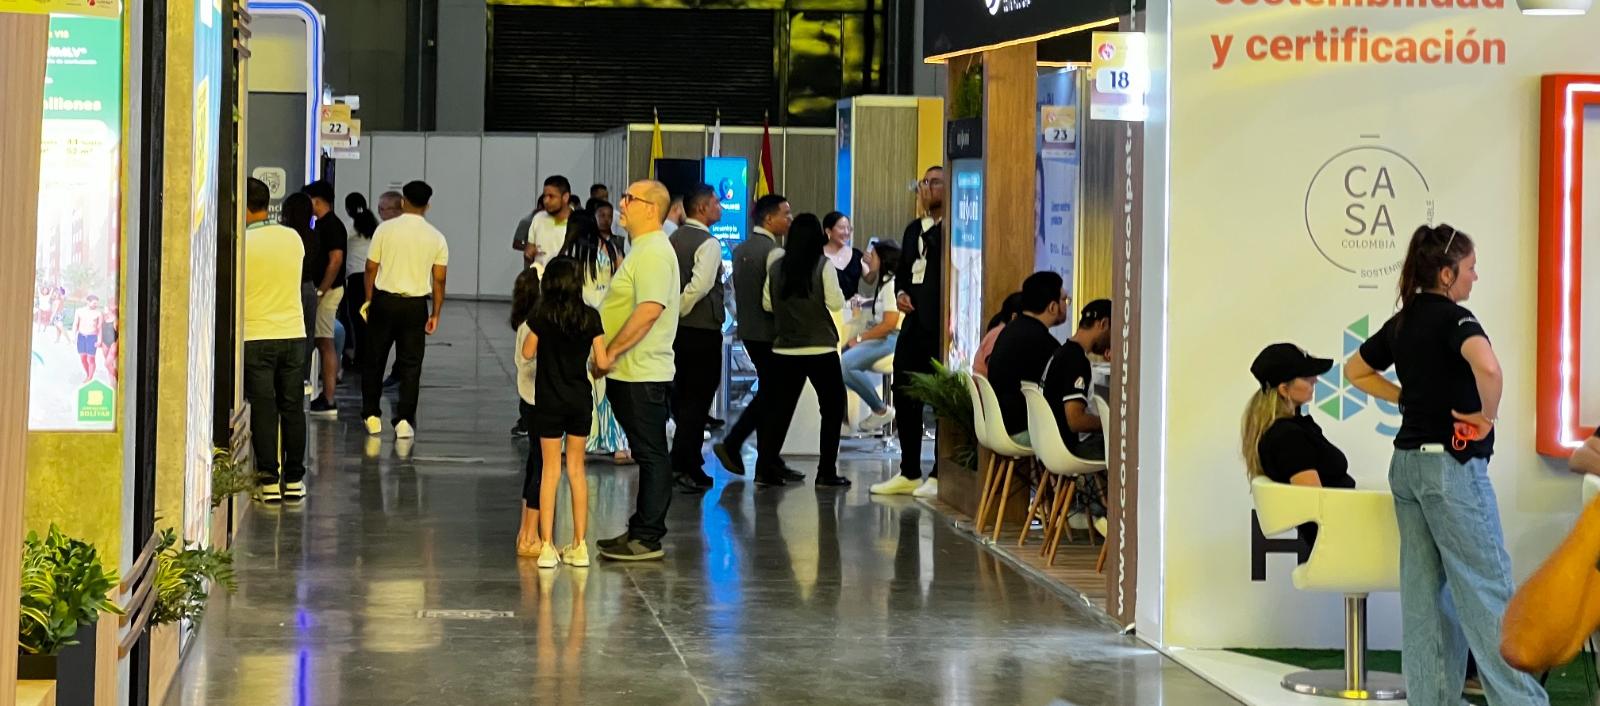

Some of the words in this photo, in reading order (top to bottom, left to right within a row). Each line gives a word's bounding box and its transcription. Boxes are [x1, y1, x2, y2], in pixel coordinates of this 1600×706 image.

[1210, 34, 1234, 70] y
[1245, 26, 1506, 65] certificación
[1110, 70, 1130, 89] 18
[329, 123, 342, 133] 22
[1053, 129, 1068, 141] 23
[1344, 165, 1396, 199] CA
[1344, 203, 1395, 236] SA
[1341, 239, 1397, 249] COLOMBIA
[1117, 121, 1134, 616] www.constructoracolpatr
